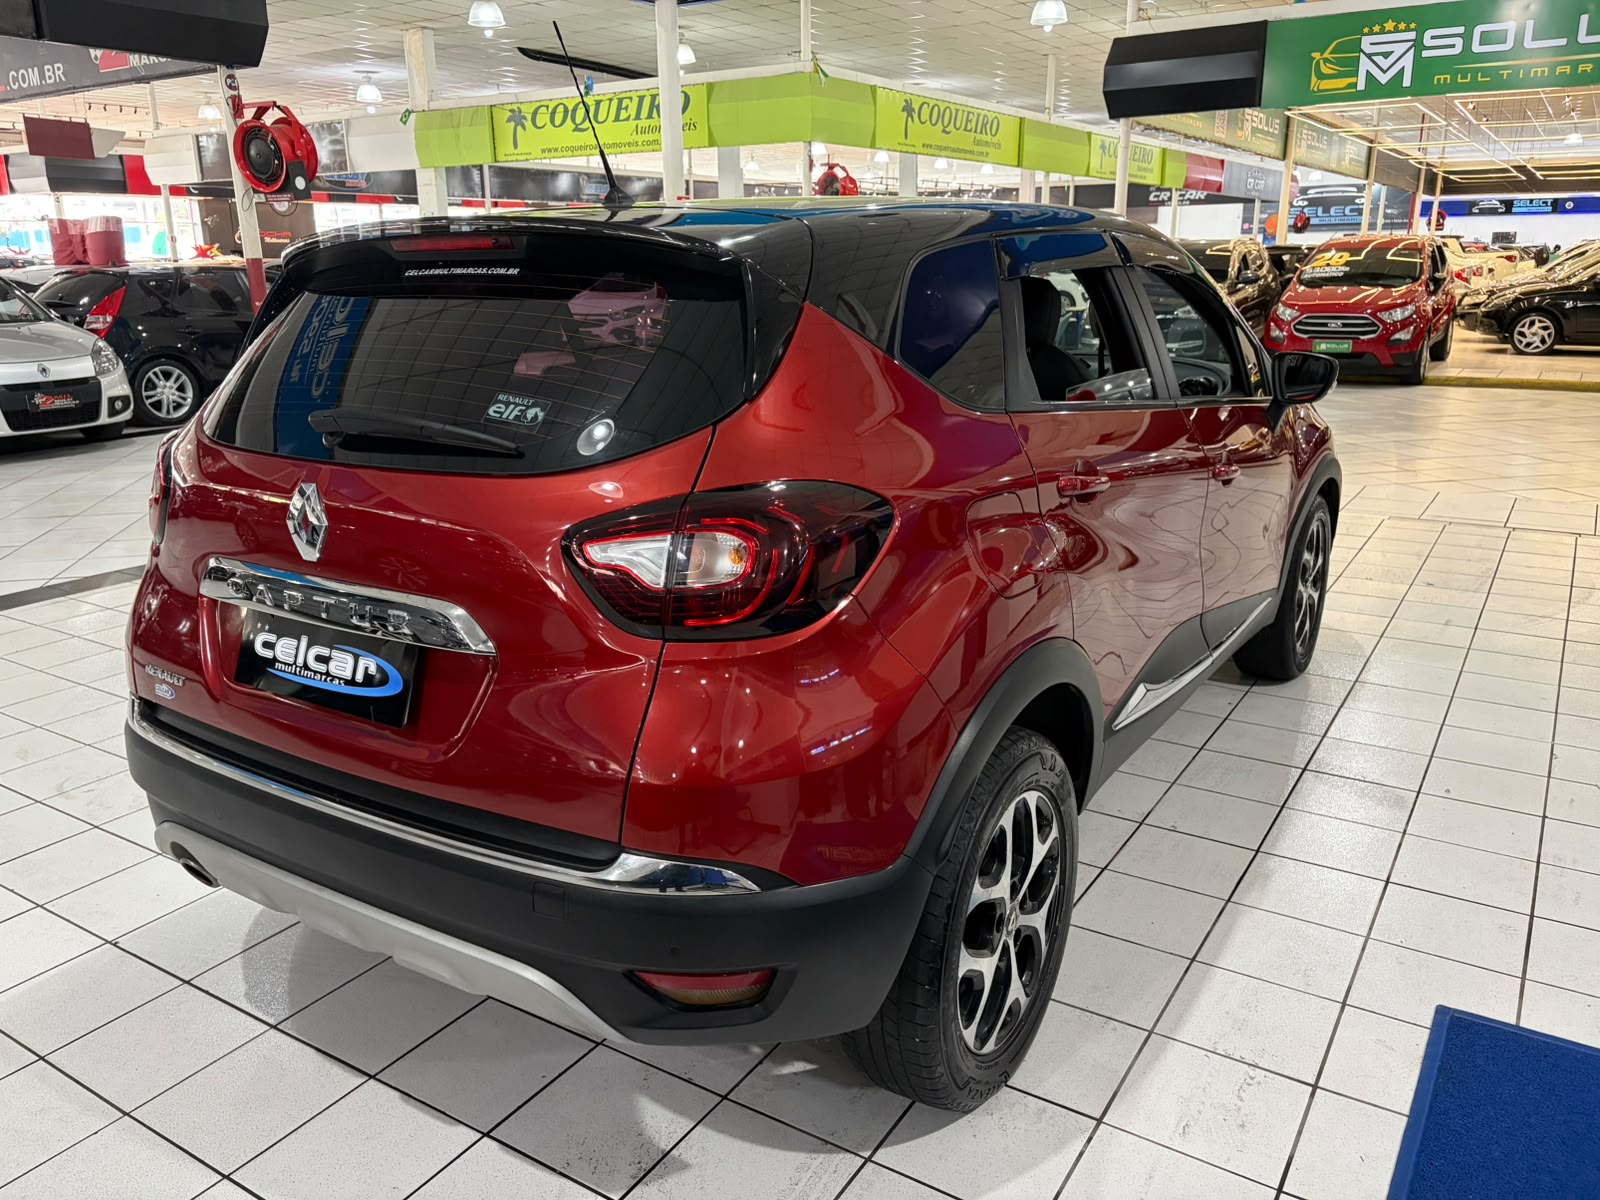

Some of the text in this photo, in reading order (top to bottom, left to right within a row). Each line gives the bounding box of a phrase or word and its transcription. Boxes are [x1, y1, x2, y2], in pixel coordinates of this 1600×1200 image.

[630, 117, 698, 137] Autoeis
[917, 101, 1001, 138] COQUEIRO
[1251, 111, 1281, 135] SOLUS
[1108, 141, 1154, 165] COEIRO
[1148, 190, 1208, 202] CR CAR
[1512, 199, 1554, 207] SELECT
[404, 267, 521, 276] CELCARMULTIMARCAS.COM.BR
[497, 394, 535, 406] RENAULT
[487, 403, 526, 420] elf
[227, 577, 413, 635] CAPTUR
[254, 632, 378, 683] celcar
[274, 661, 346, 687] multimarcas
